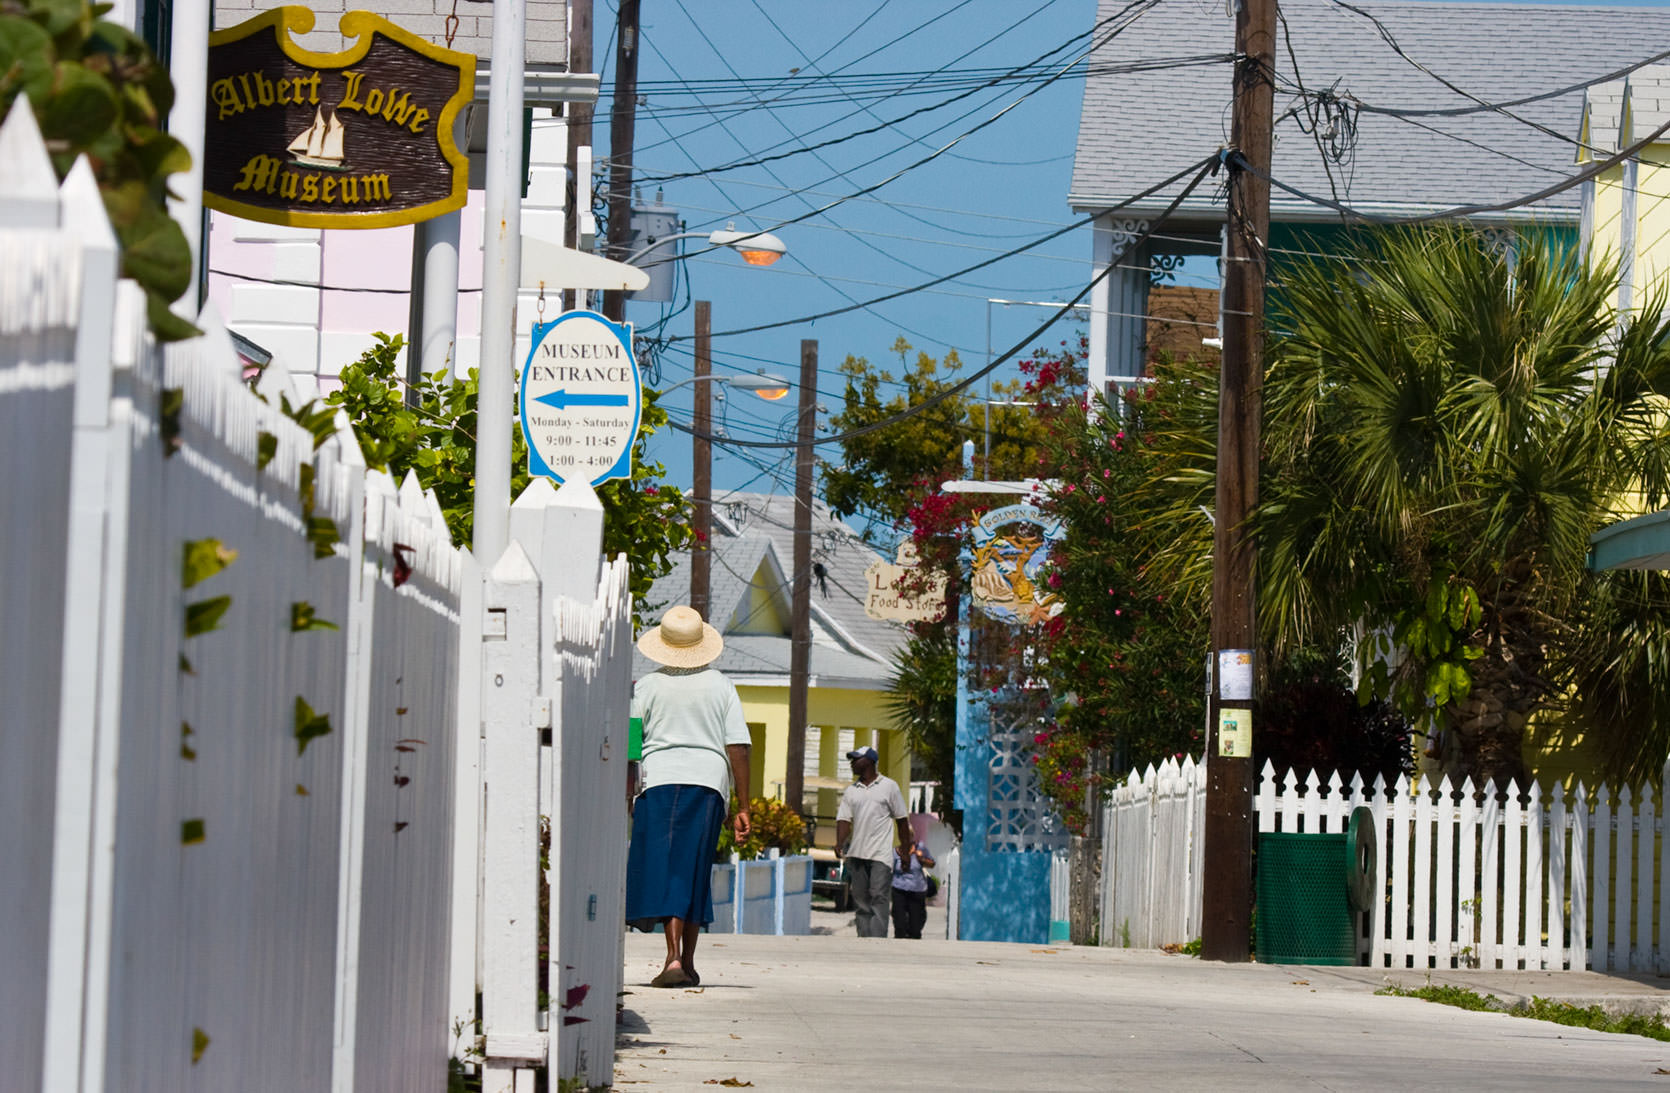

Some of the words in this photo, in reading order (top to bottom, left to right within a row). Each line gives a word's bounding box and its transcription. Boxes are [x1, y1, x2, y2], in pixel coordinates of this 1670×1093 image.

[211, 70, 322, 120] Albert
[336, 71, 431, 134] Lowe
[233, 153, 393, 204] Museum
[542, 343, 621, 360] MUSEUM
[532, 366, 630, 383] ENTRANCE
[531, 416, 572, 430] Monday
[583, 417, 630, 431] Saturday
[546, 435, 572, 447] 9:00
[585, 435, 617, 448] 11:45
[550, 455, 575, 467] 1:00
[587, 455, 613, 467] 4:00
[983, 508, 1027, 528] GOLDEN
[870, 594, 899, 609] Food
